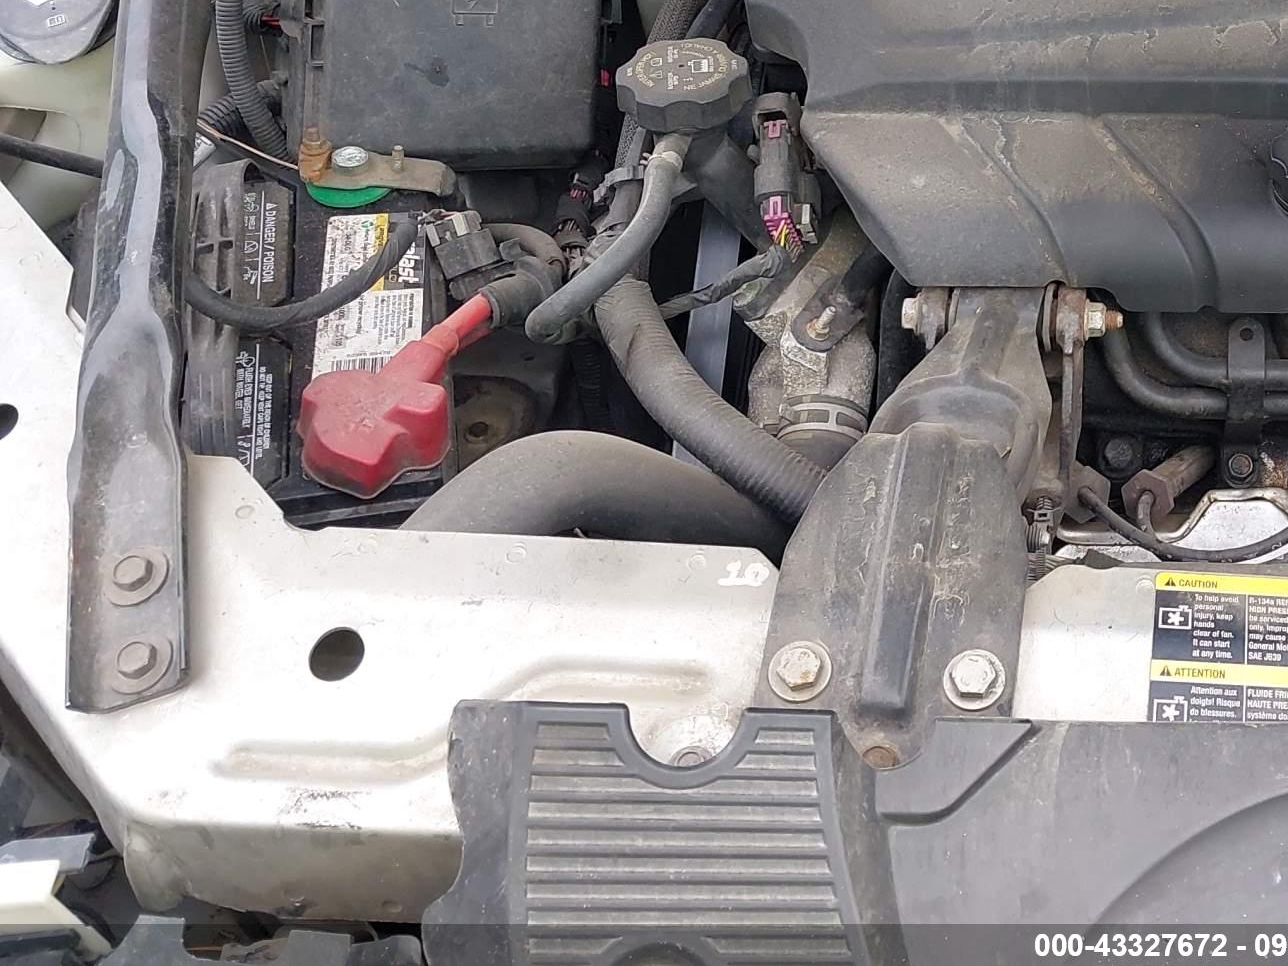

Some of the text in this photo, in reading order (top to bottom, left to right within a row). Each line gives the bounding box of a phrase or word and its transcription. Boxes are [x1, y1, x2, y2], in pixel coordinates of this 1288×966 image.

[264, 211, 276, 244] DANGER
[262, 251, 275, 283] POISON
[1179, 580, 1218, 588] CAUTION
[1204, 595, 1219, 603] help
[1194, 604, 1224, 612] personal
[1216, 613, 1233, 621] keep
[1214, 640, 1230, 648] start
[1249, 642, 1275, 650] General
[1215, 651, 1233, 659] time.
[1249, 652, 1263, 660] SAE
[1174, 668, 1226, 679] ATTENTION
[1191, 686, 1222, 695] Attention
[1248, 689, 1273, 698] FLUIDE
[1190, 696, 1241, 708] doigts! Risque
[1247, 700, 1271, 709] HAUTE
[1201, 709, 1236, 718] blessures.
[1247, 711, 1276, 720] système
